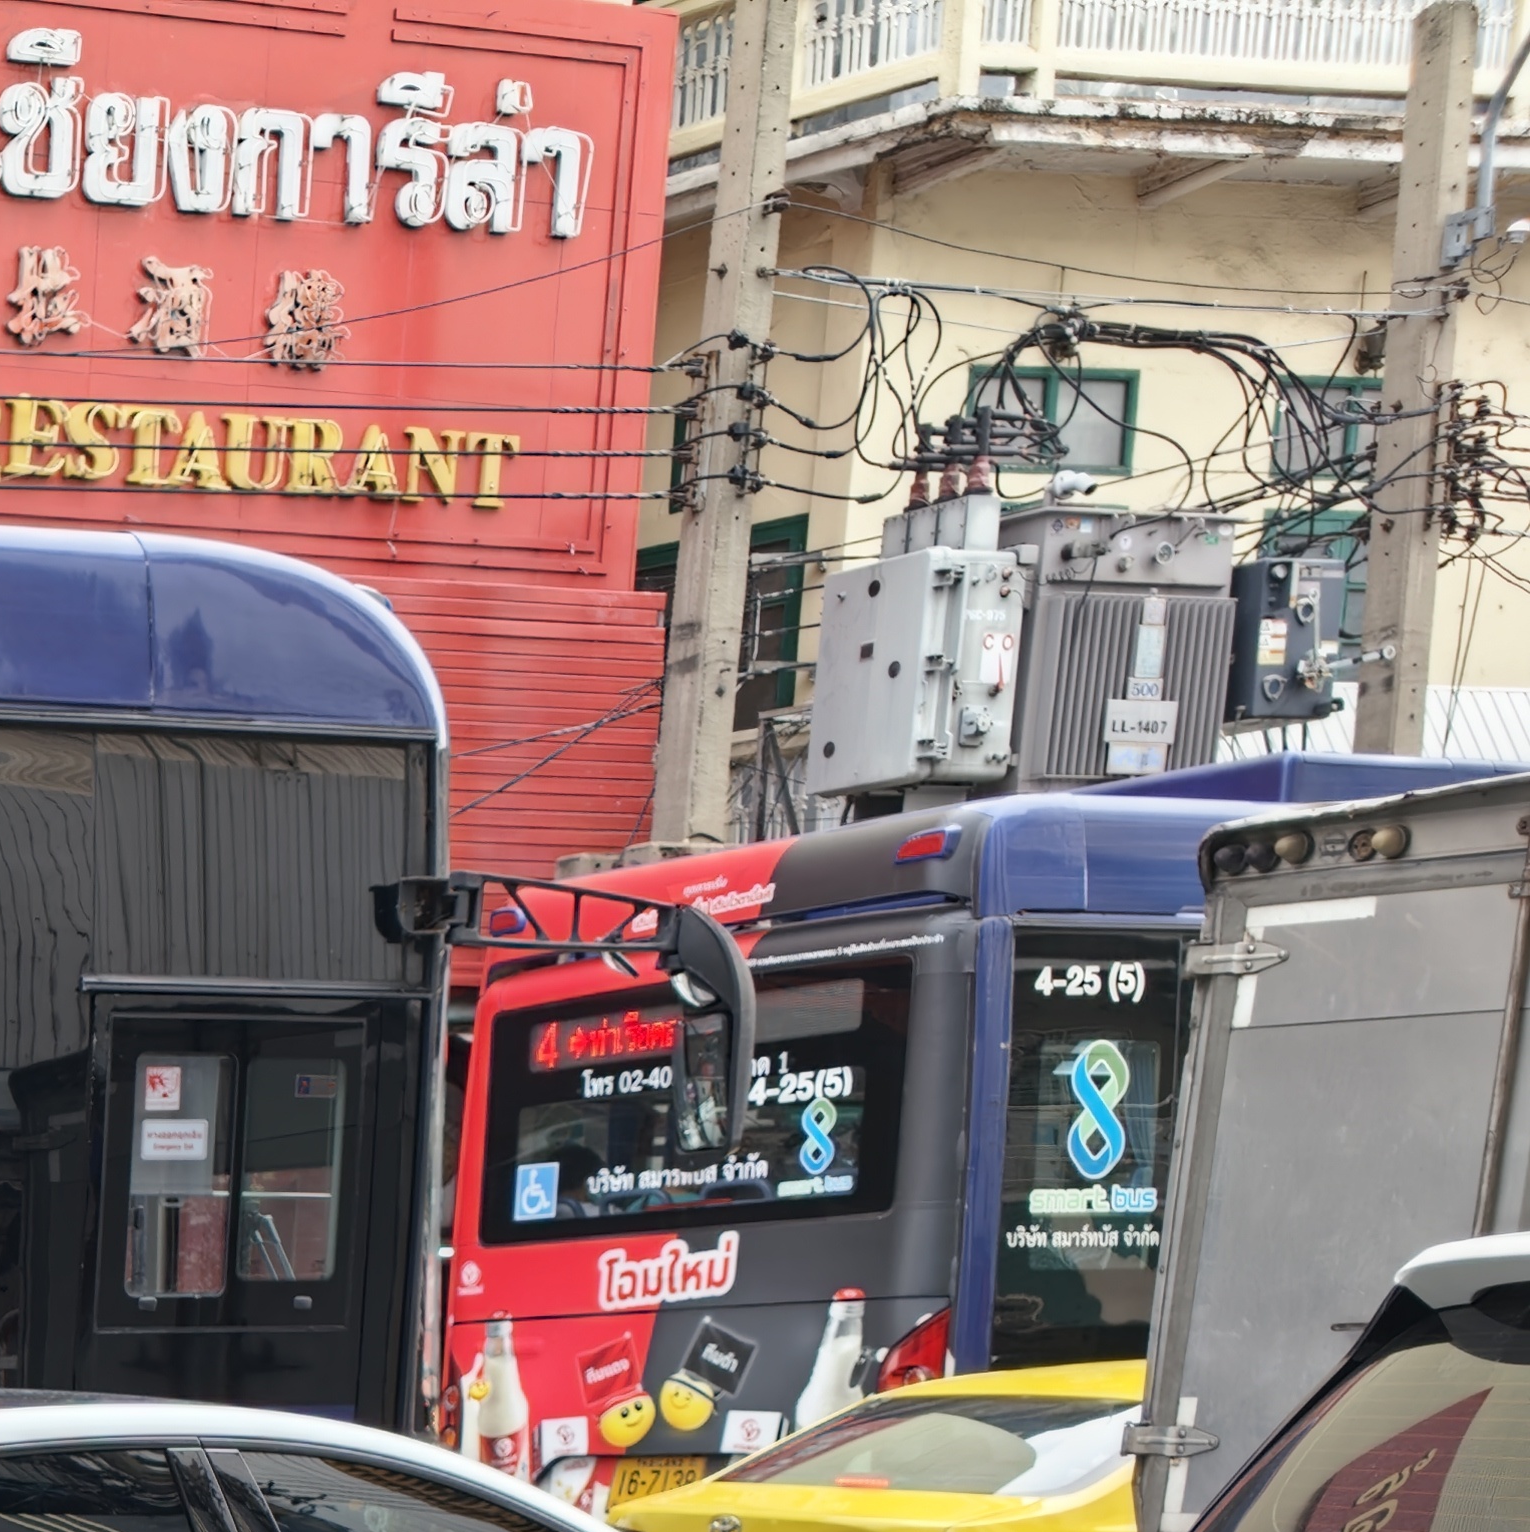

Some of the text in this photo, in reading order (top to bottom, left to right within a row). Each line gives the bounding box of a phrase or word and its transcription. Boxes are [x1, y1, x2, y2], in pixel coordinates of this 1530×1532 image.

[1131, 683, 1158, 696] 500
[1111, 720, 1168, 733] LL-1407
[1035, 961, 1145, 1002] 4-25 (5)
[536, 1021, 558, 1070] 4
[581, 1066, 673, 1098] โทร 02-40
[723, 1152, 769, 1182] จำกัด
[1029, 1185, 1158, 1213] smart bus
[1007, 1225, 1047, 1248] บริษัท
[600, 1234, 736, 1305] โฉมใหม่
